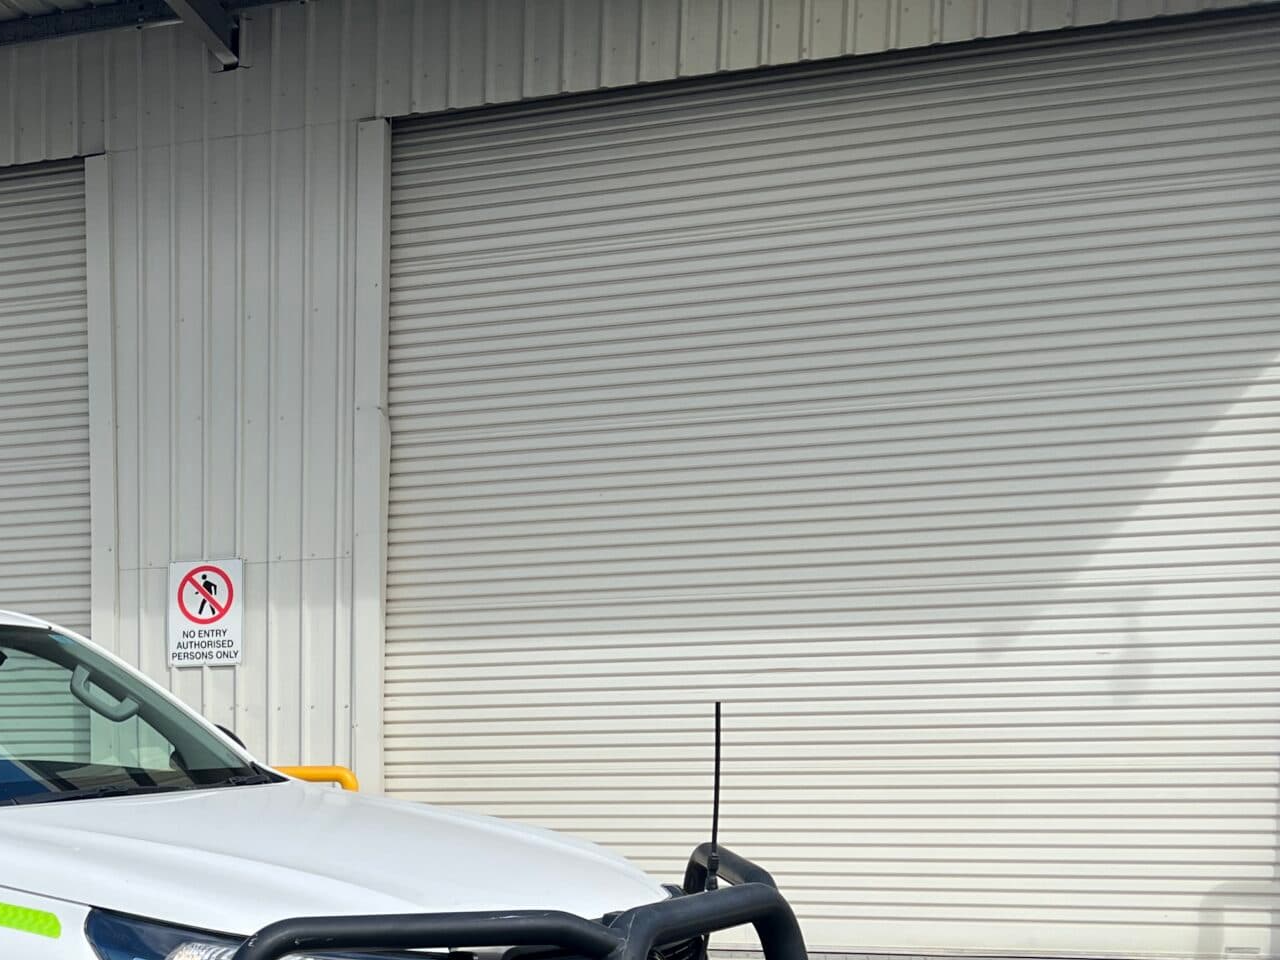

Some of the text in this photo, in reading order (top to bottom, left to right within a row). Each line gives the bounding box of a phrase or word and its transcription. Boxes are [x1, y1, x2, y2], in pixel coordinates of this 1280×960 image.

[182, 629, 228, 639] NO ENTRY
[176, 639, 234, 650] AUTHORISED
[172, 650, 239, 660] PERSONS ONLY
